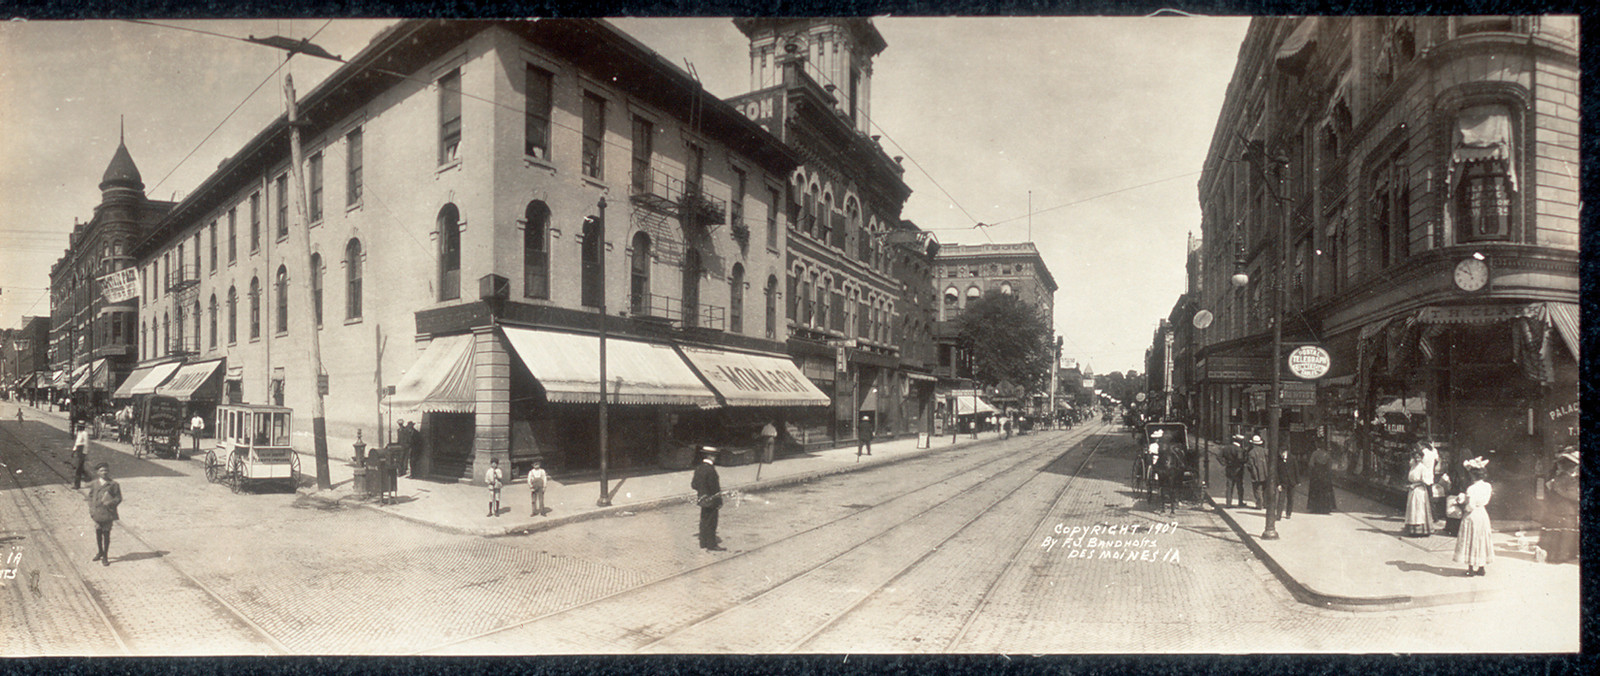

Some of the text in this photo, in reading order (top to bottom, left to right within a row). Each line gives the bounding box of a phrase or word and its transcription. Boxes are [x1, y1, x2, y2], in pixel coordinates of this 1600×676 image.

[1298, 348, 1320, 357] POSTAL
[1293, 355, 1327, 364] TELEGRAPH
[716, 364, 810, 393] MONARCH
